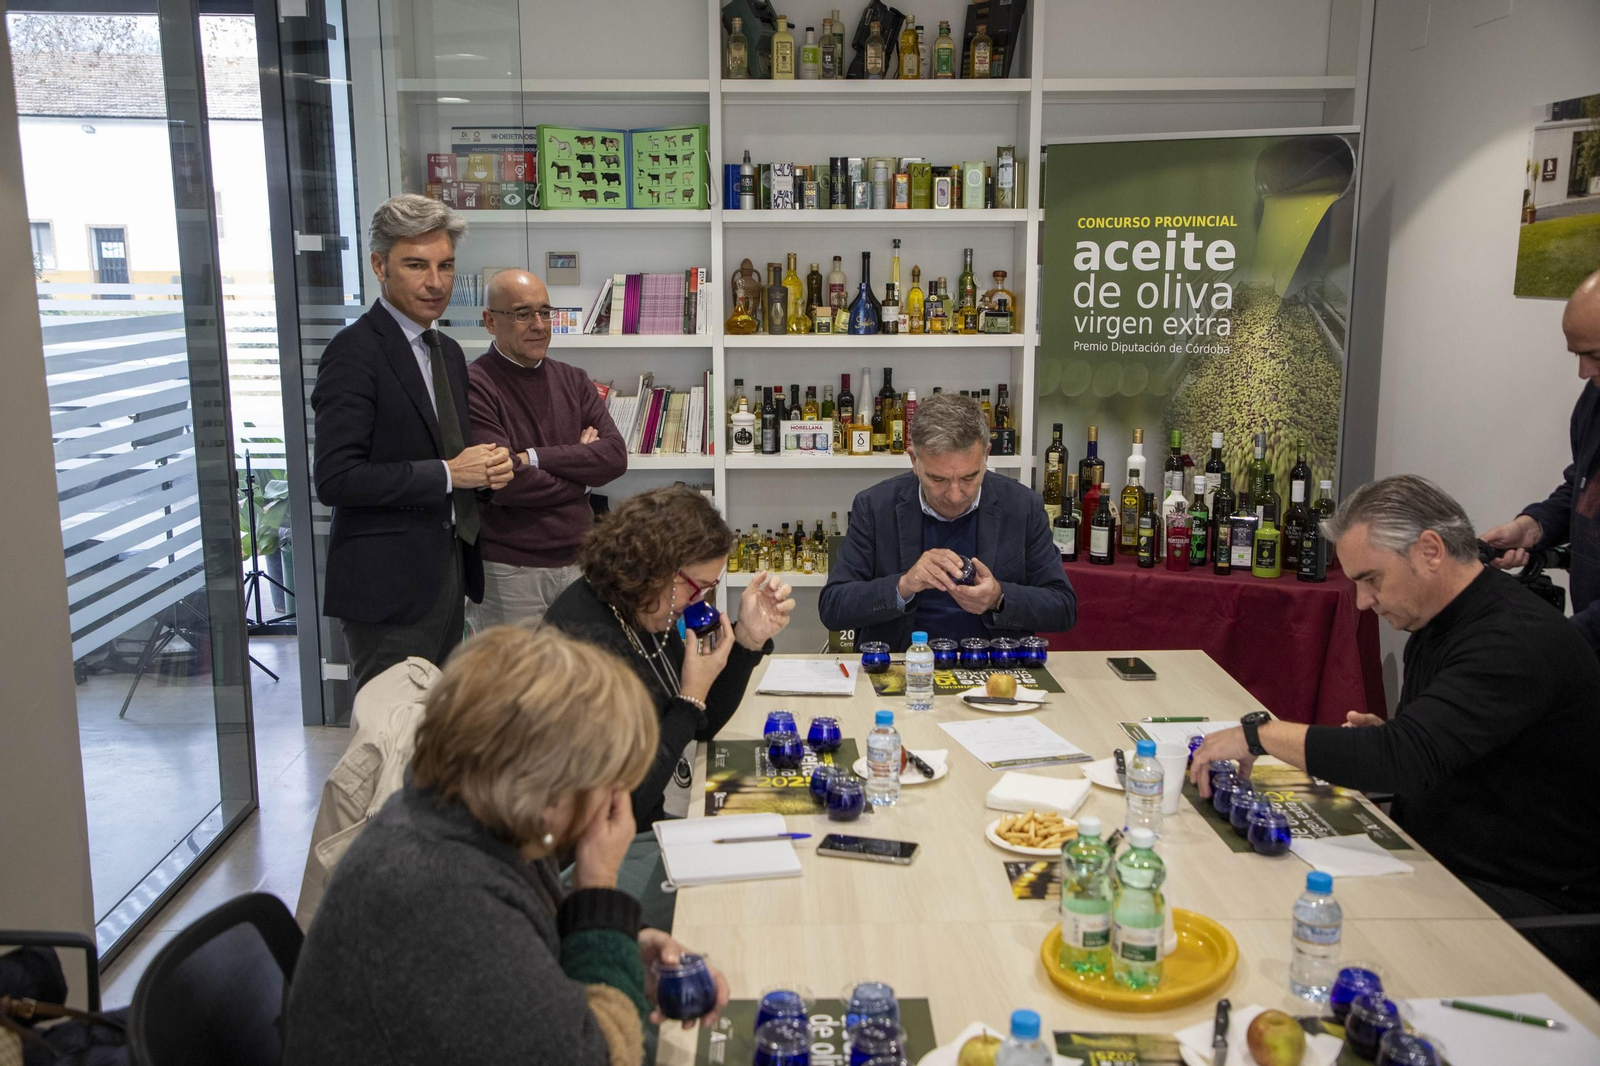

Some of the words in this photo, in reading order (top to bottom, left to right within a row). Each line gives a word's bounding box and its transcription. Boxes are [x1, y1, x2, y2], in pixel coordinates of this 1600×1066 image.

[1077, 217, 1150, 229] CONCURSO
[1154, 215, 1238, 228] PROVINCIAL
[1073, 229, 1236, 271] aceite
[1073, 273, 1121, 309] de
[1136, 273, 1233, 310] oliva
[1073, 311, 1152, 340] virgen
[1162, 313, 1231, 336] extra
[1073, 341, 1109, 353] Premio
[1111, 341, 1166, 356] Diputación
[1169, 342, 1183, 354] de
[1184, 341, 1231, 355] Córdoba
[809, 1014, 841, 1038] de
